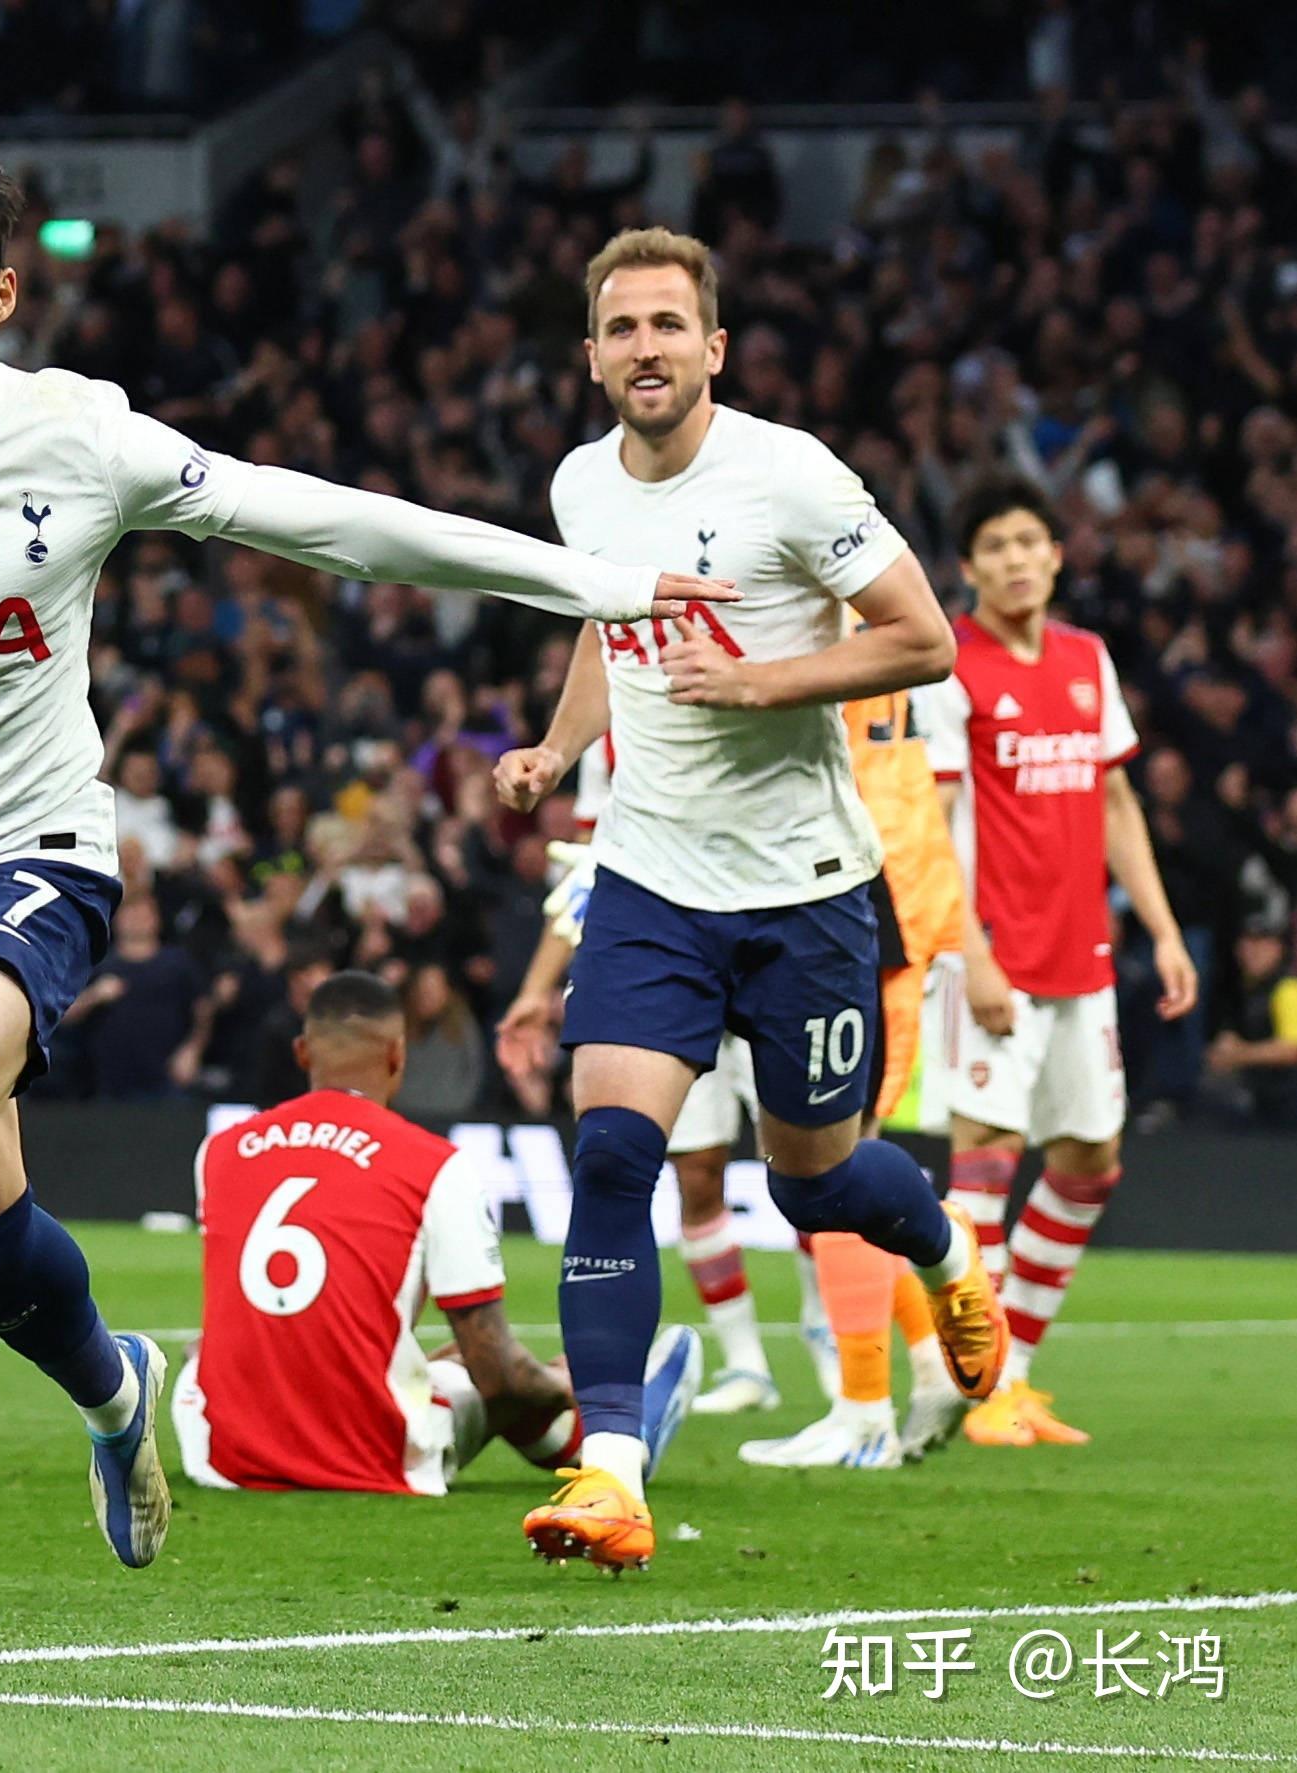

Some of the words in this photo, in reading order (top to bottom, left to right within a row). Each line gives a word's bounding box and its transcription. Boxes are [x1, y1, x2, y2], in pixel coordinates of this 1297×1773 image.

[2, 869, 61, 928] 7
[805, 1007, 864, 1083] 10
[237, 1121, 382, 1169] GABRIEL
[239, 1176, 329, 1317] 6
[564, 1255, 637, 1272] SPURS
